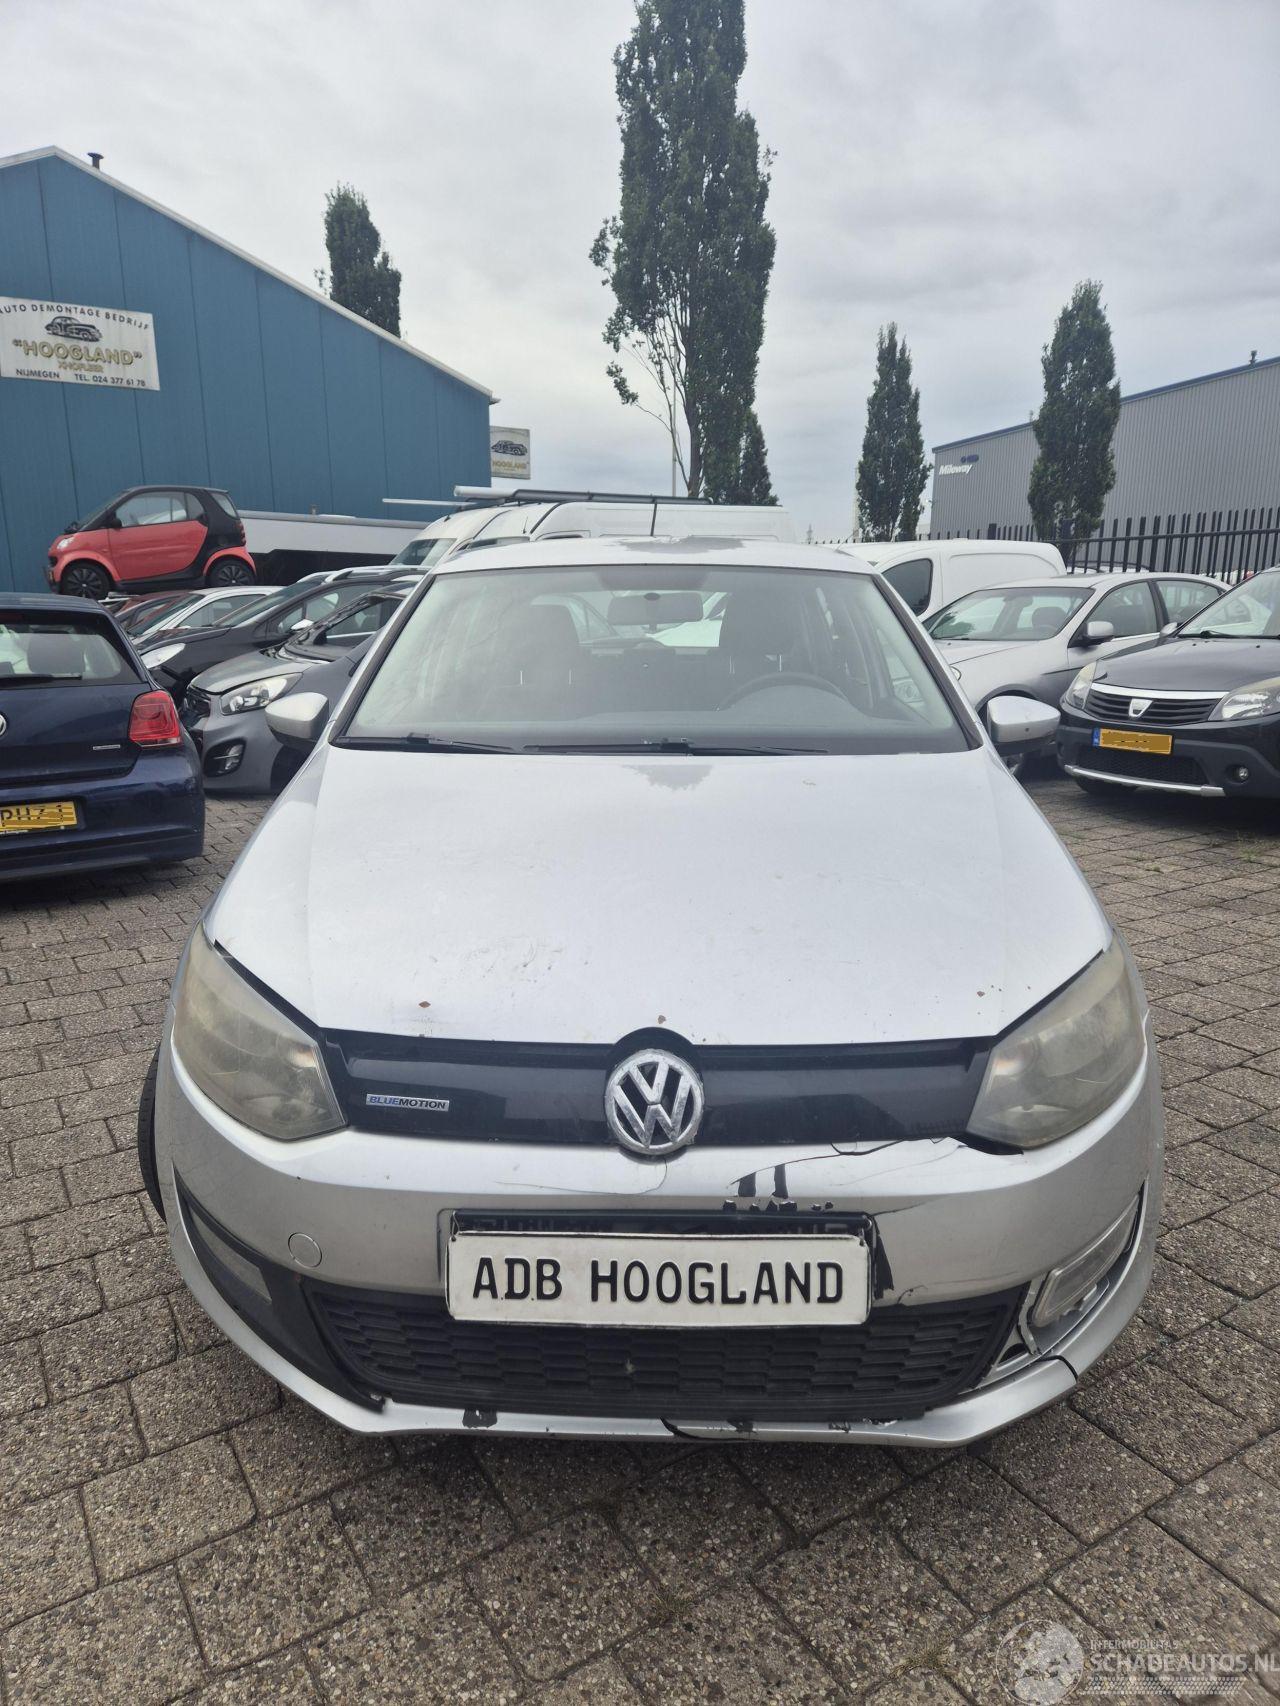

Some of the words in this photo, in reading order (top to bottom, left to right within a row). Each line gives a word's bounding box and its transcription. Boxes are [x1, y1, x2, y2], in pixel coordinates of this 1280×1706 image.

[32, 305, 100, 317] DEMONTAGE
[105, 312, 149, 330] BEDRIJF
[15, 368, 60, 379] NIJMEGEN
[110, 376, 124, 385] 377
[369, 1096, 447, 1110] BLUEMOTION
[590, 1260, 844, 1305] HOOGLAND
